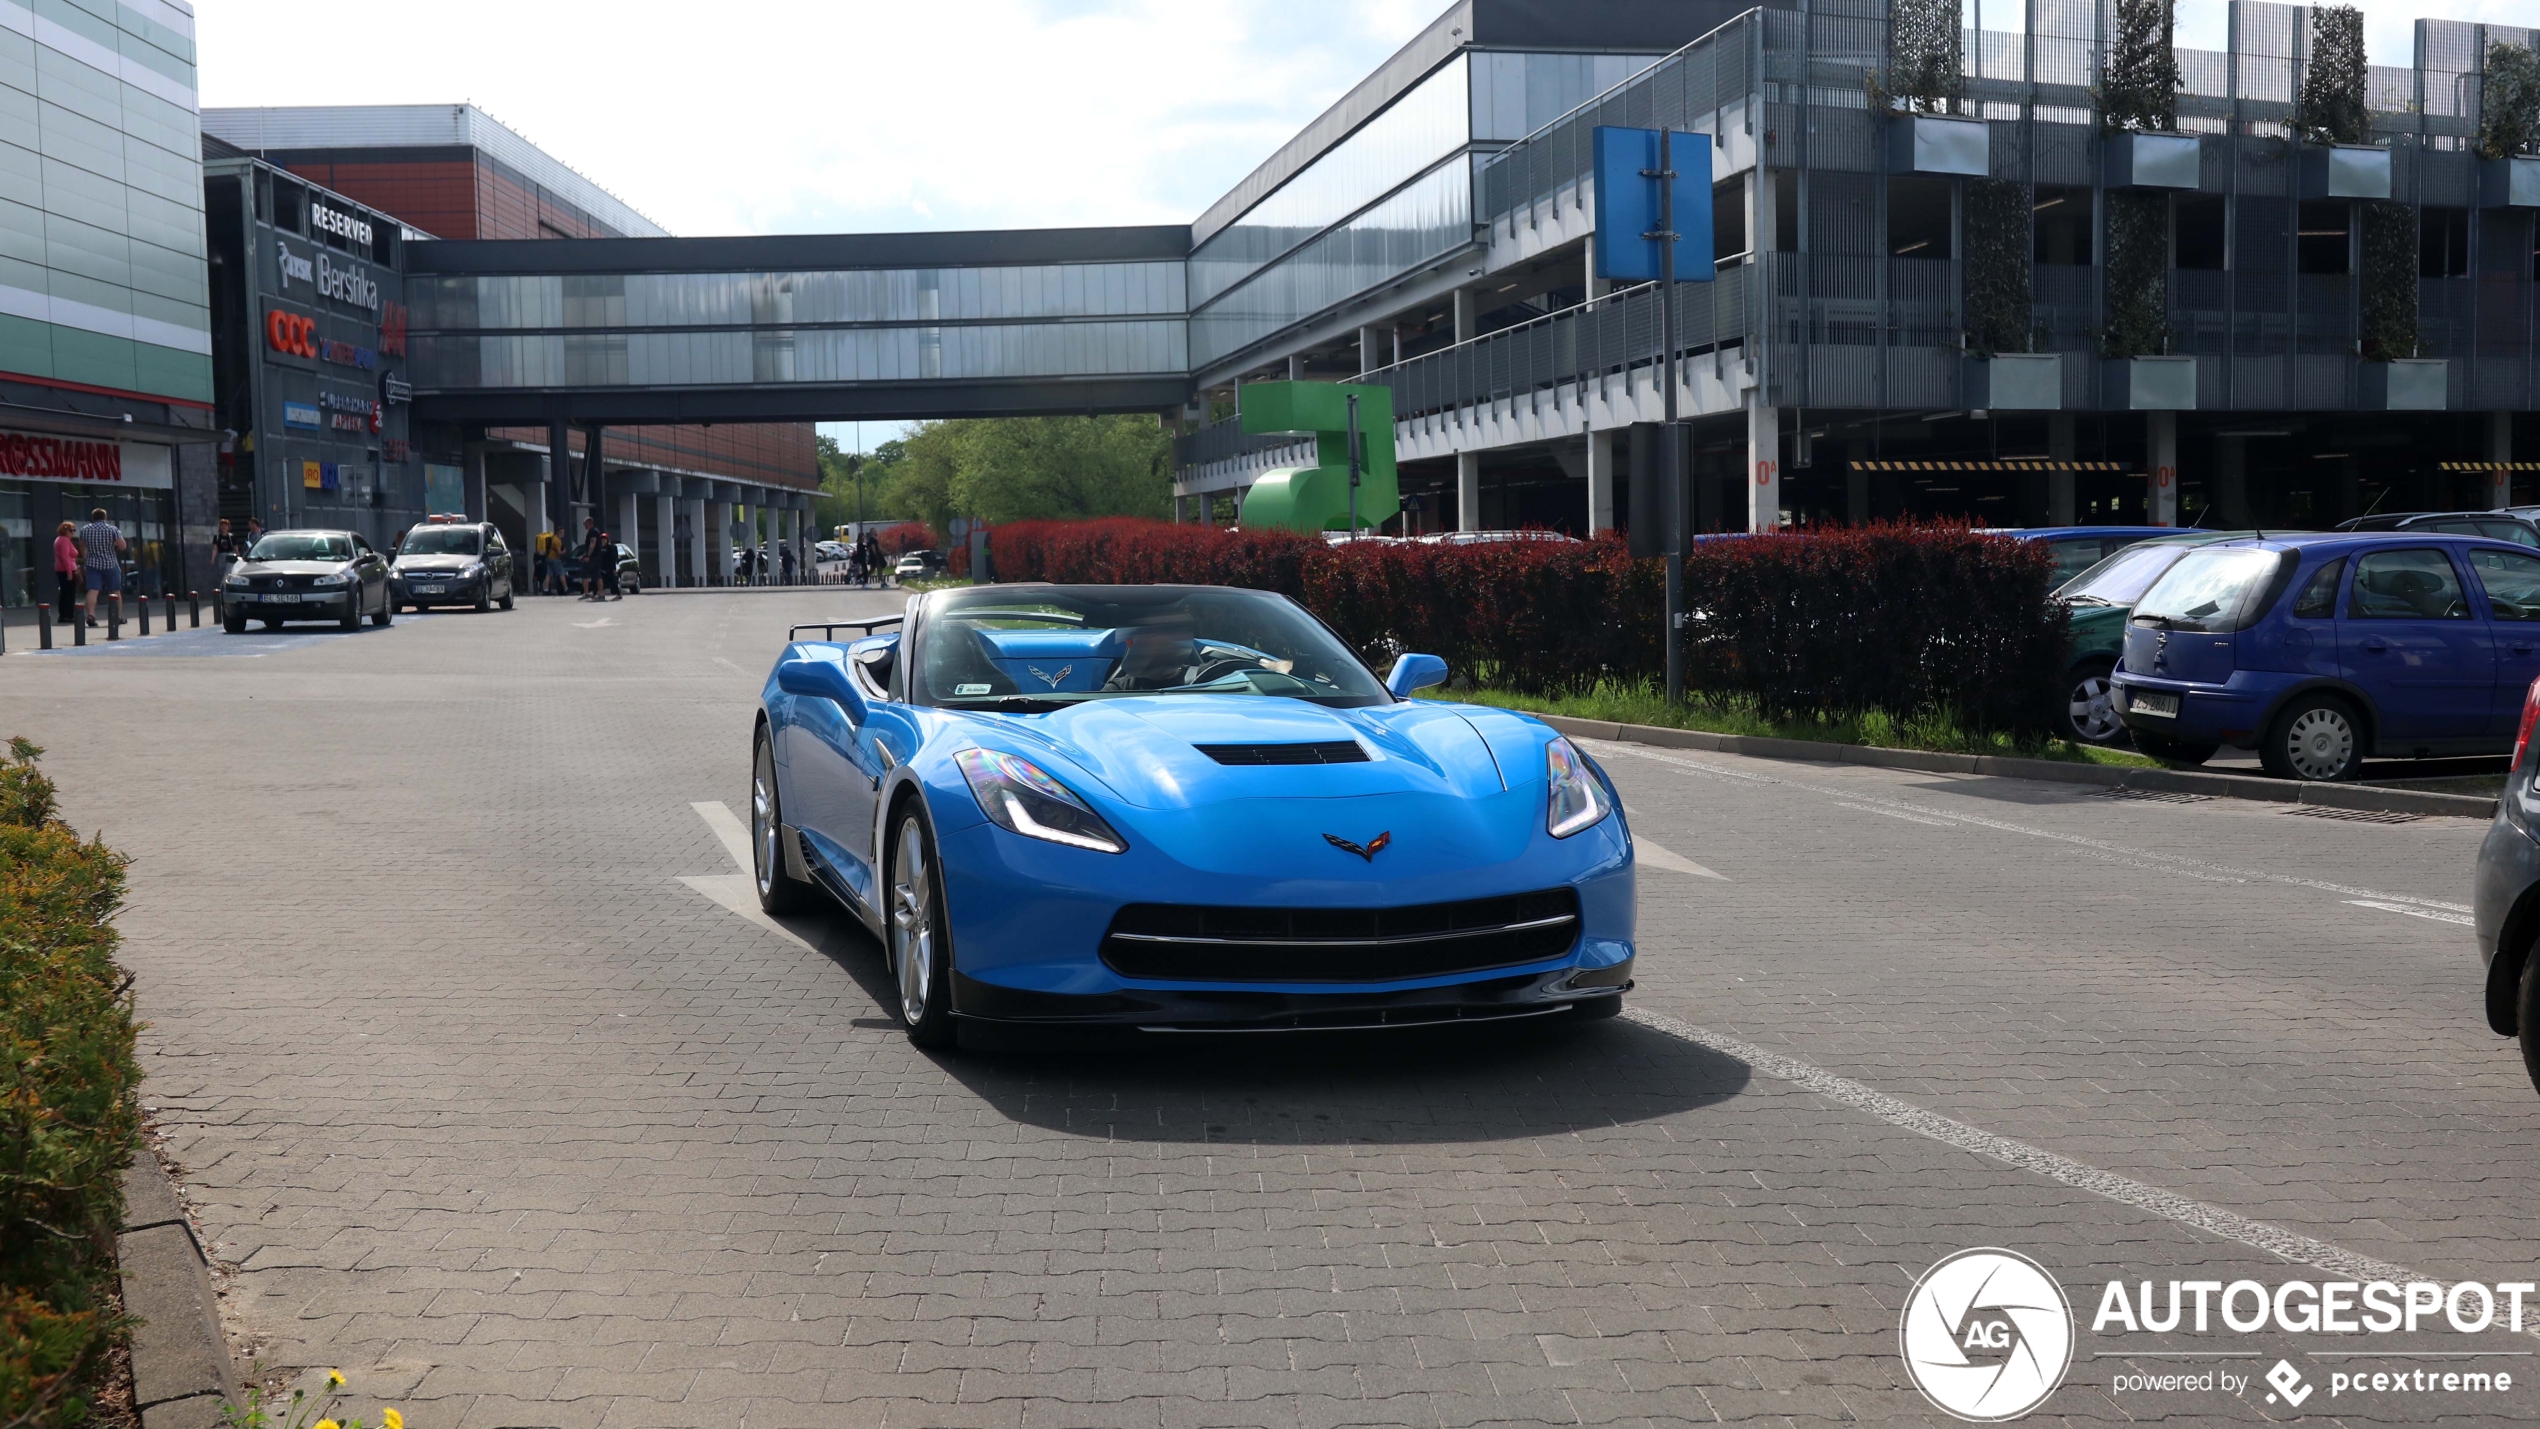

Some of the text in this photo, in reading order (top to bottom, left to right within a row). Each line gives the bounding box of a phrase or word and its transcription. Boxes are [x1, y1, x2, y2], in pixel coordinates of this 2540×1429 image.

[311, 202, 373, 246] RESERVED
[286, 253, 313, 282] JYSK
[315, 252, 378, 311] Bershka
[267, 309, 316, 359] CCC
[333, 413, 365, 432] APTEKA
